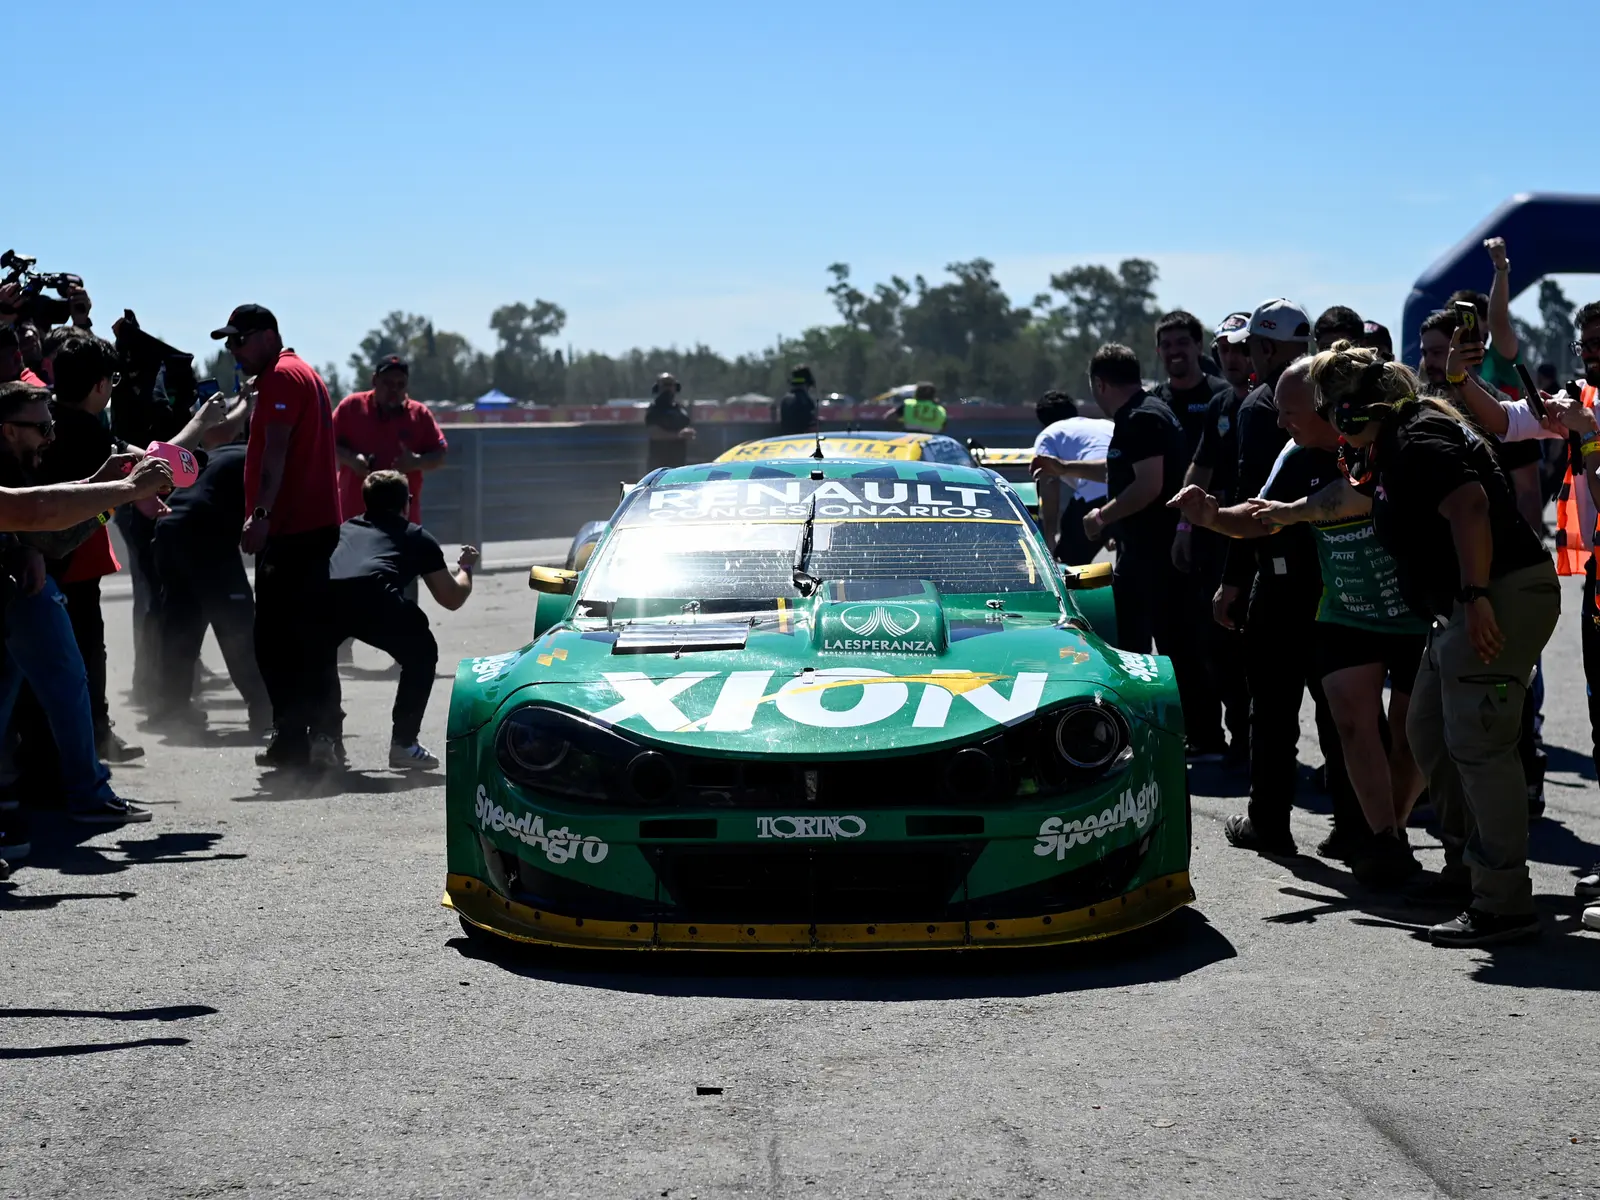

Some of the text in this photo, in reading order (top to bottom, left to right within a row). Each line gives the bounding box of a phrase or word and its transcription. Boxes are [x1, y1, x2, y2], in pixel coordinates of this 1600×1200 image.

[735, 442, 906, 456] RENAULT
[648, 481, 991, 510] RENAULT
[648, 504, 993, 520] CONCESONARIOS
[1331, 552, 1357, 560] FAIN
[593, 668, 1048, 732] XION
[475, 784, 609, 865] SpeedAgro
[757, 815, 867, 841] TORINO
[1033, 780, 1159, 861] SpeedAgro
